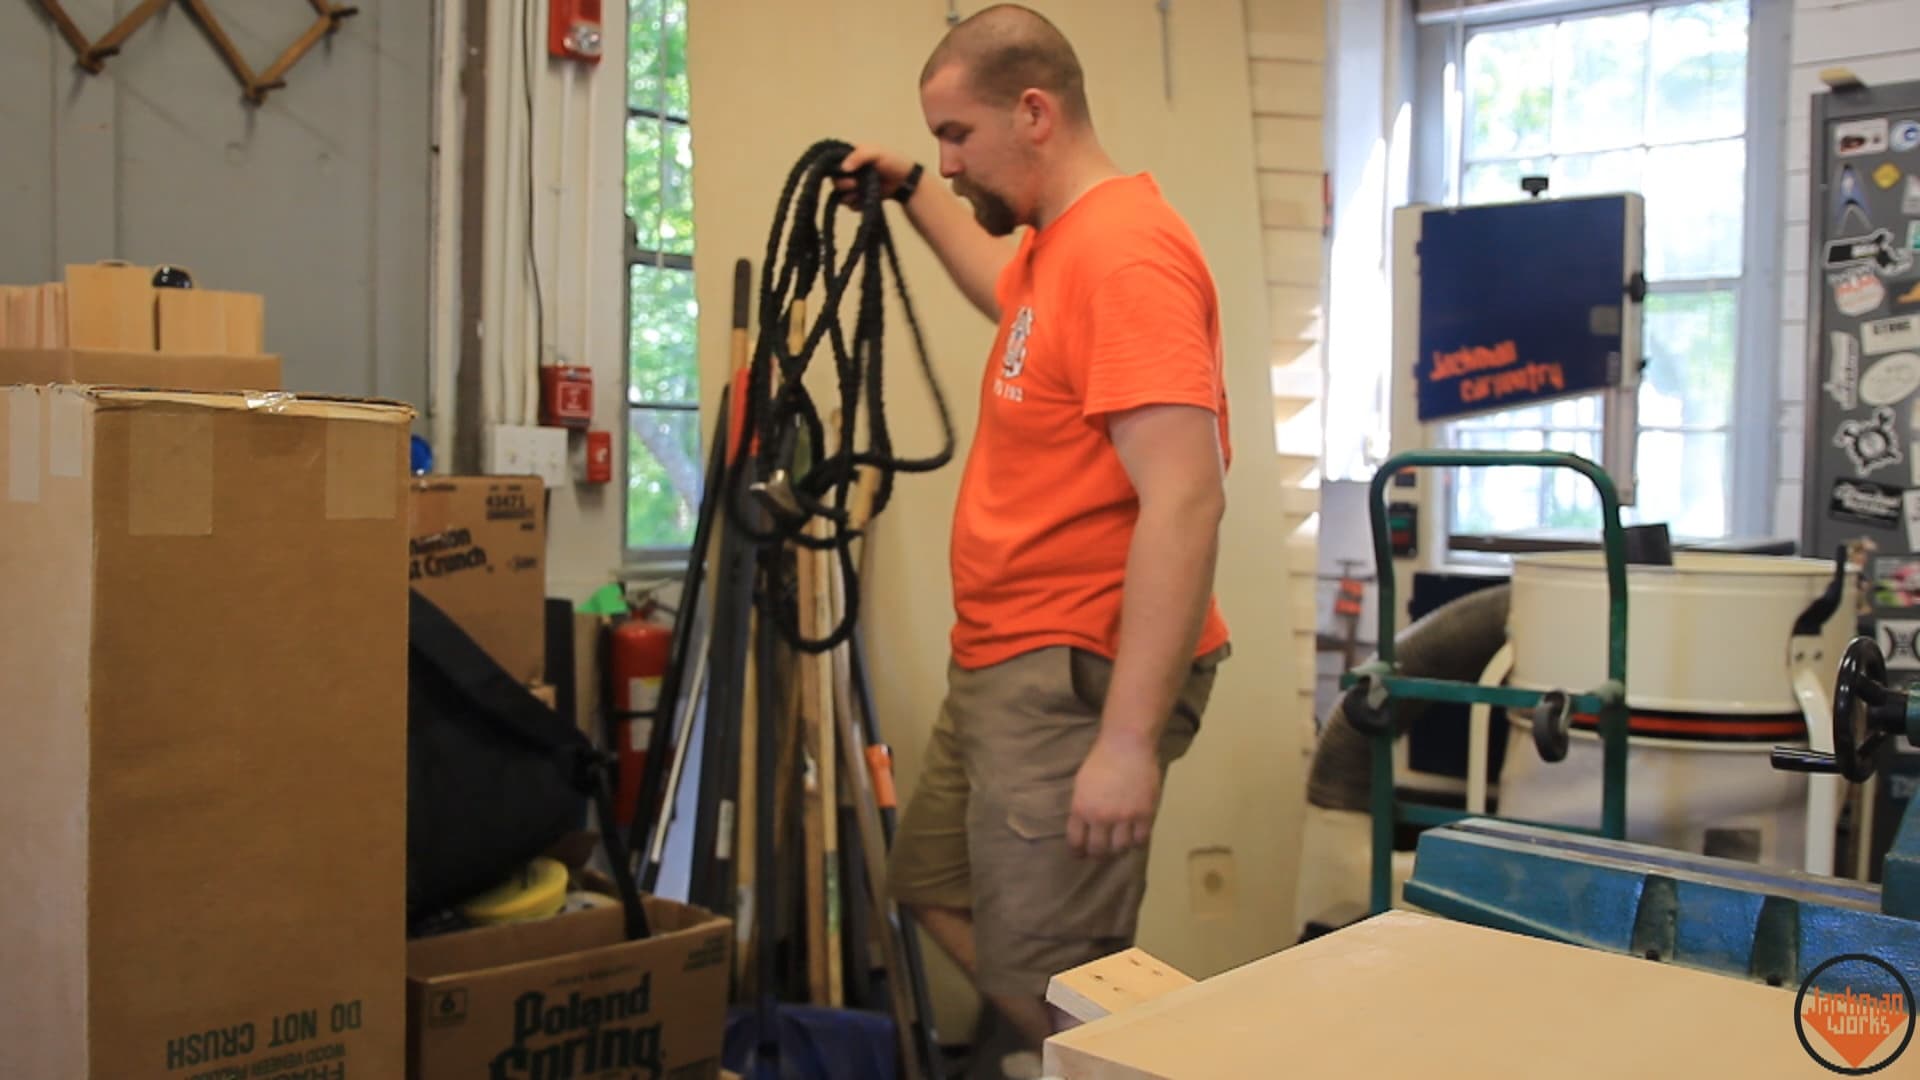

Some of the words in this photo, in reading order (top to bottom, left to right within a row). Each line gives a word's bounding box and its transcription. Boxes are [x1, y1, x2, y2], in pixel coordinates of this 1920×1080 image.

[268, 1008, 318, 1048] NOT
[329, 1000, 362, 1033] DO
[514, 971, 651, 1043] Poland
[166, 1022, 256, 1070] CRUSH
